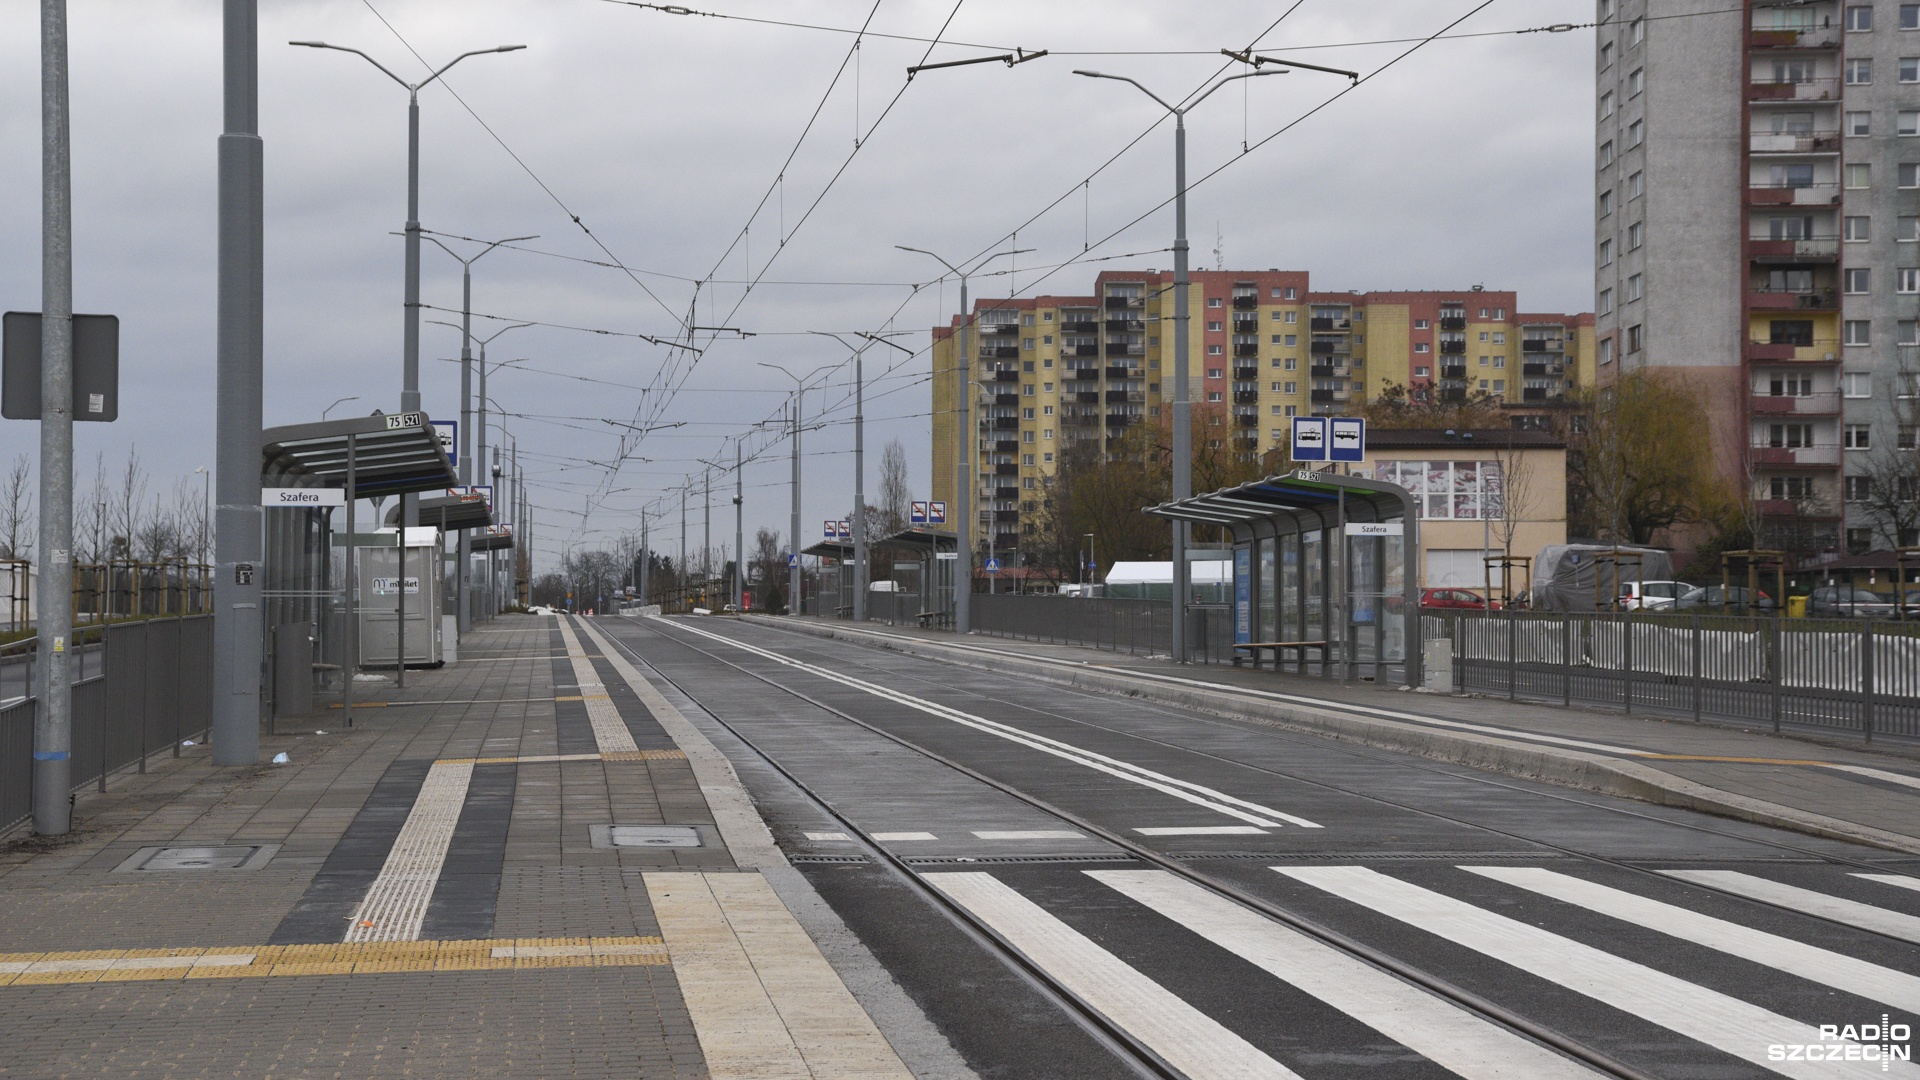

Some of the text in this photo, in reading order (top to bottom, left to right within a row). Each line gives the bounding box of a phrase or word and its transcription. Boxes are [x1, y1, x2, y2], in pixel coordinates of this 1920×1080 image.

[389, 414, 419, 428] 75 521
[1300, 471, 1320, 482] 75 521
[280, 492, 319, 502] Szafera
[1361, 525, 1387, 533] Szafera
